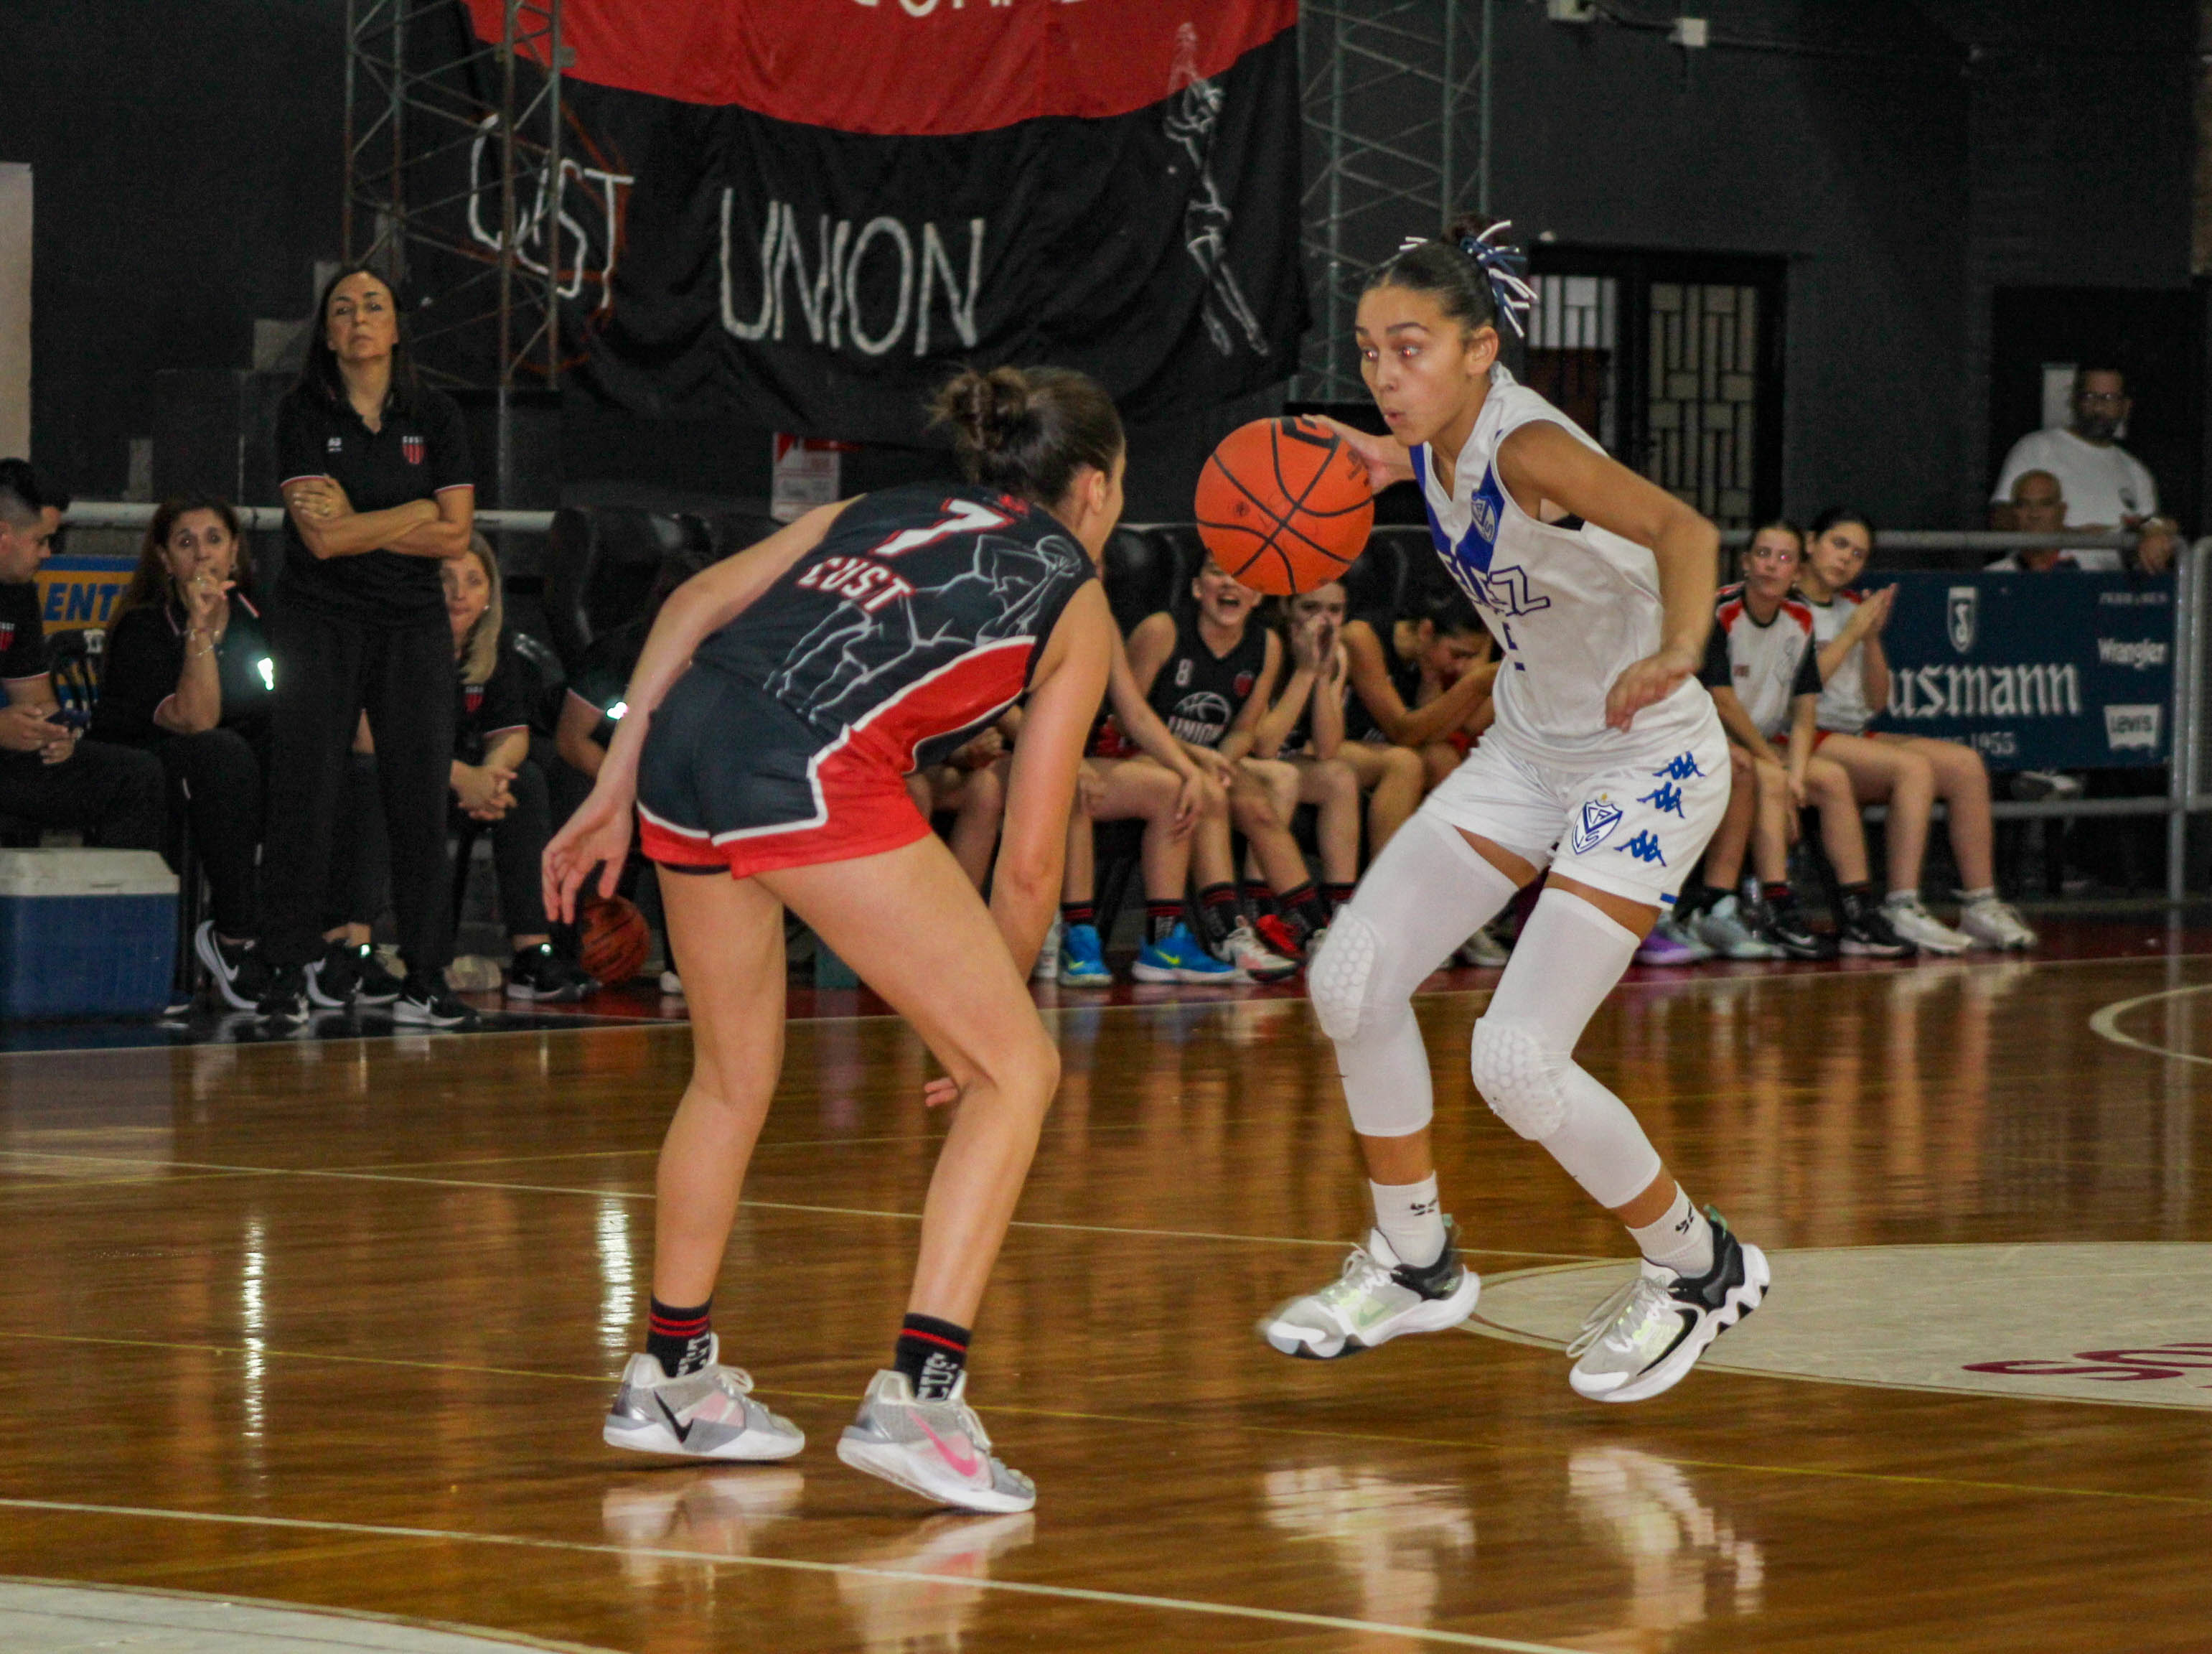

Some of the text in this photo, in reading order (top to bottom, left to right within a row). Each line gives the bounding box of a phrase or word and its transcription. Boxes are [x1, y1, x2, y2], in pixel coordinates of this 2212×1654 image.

[721, 187, 983, 356] UNION
[869, 498, 1015, 556] 7
[40, 582, 123, 622] ENT
